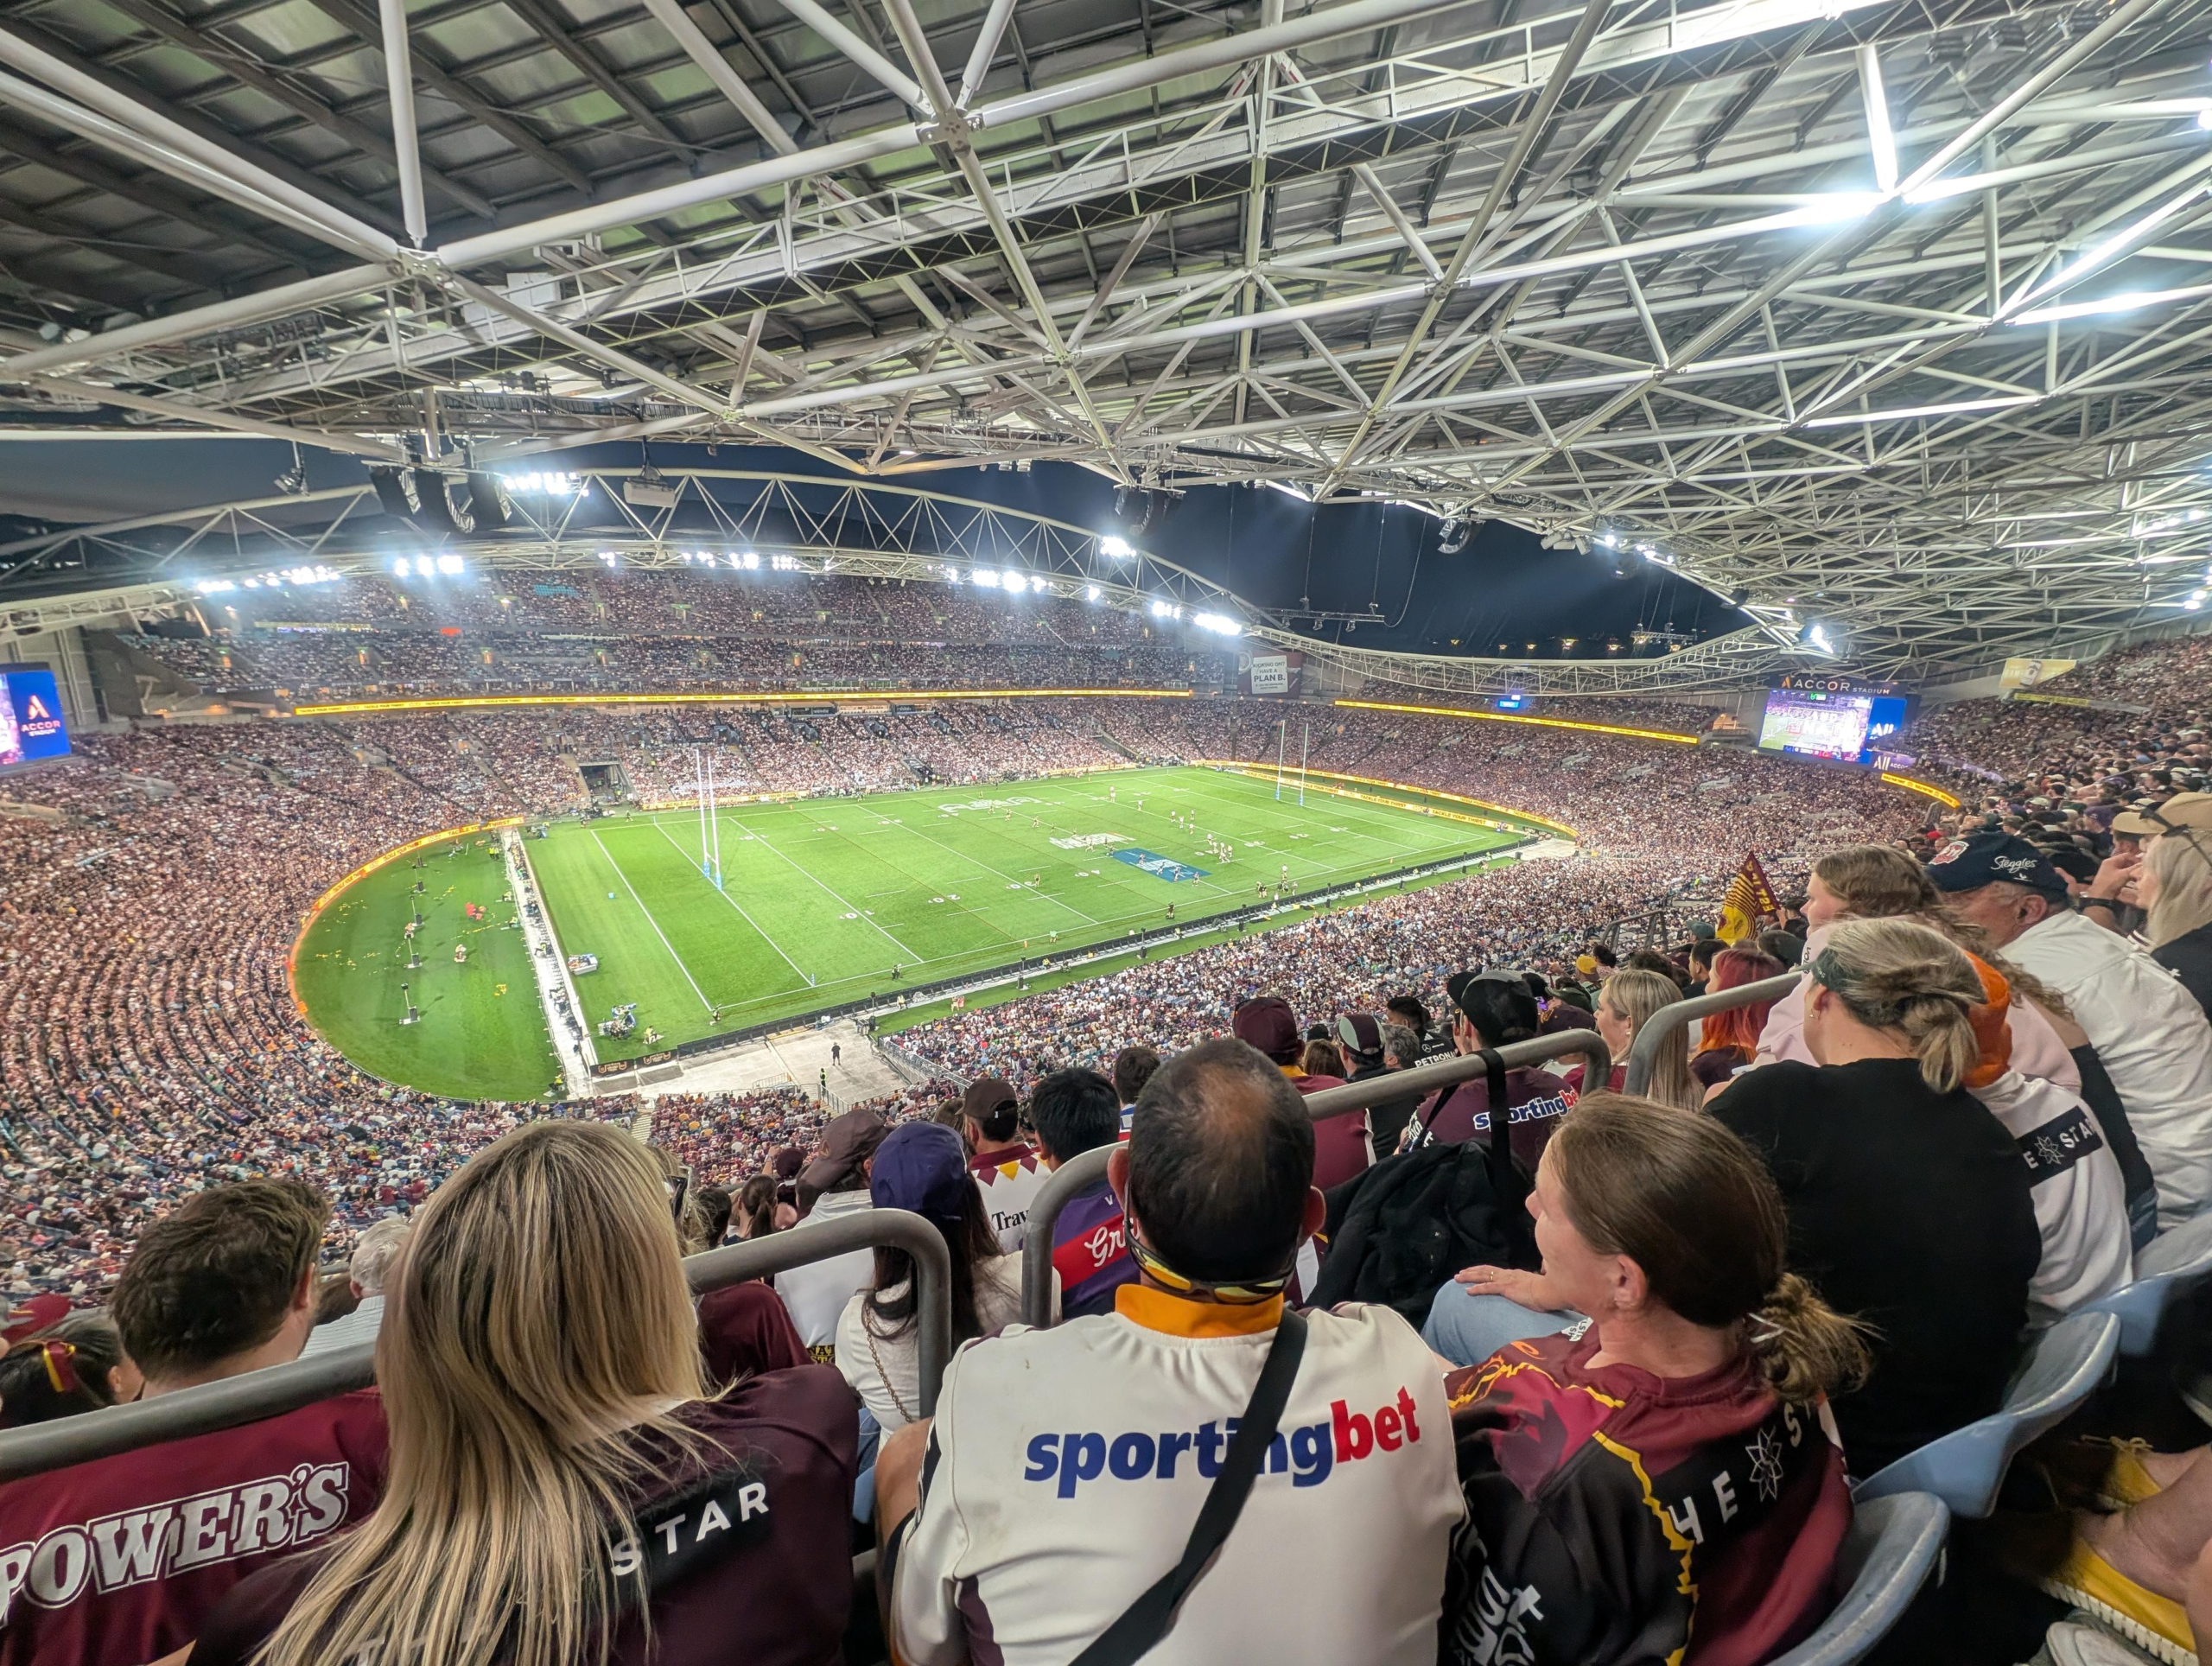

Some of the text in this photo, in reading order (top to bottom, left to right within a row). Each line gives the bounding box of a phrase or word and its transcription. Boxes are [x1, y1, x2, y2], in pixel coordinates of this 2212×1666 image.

[1795, 679, 1850, 690] ACCOR
[21, 721, 60, 732] ACCOR
[1991, 855, 2038, 874] Steggles
[1024, 1385, 1421, 1499] sportingbet
[0, 1461, 349, 1628] POWER'S
[611, 1482, 769, 1576] STAR
